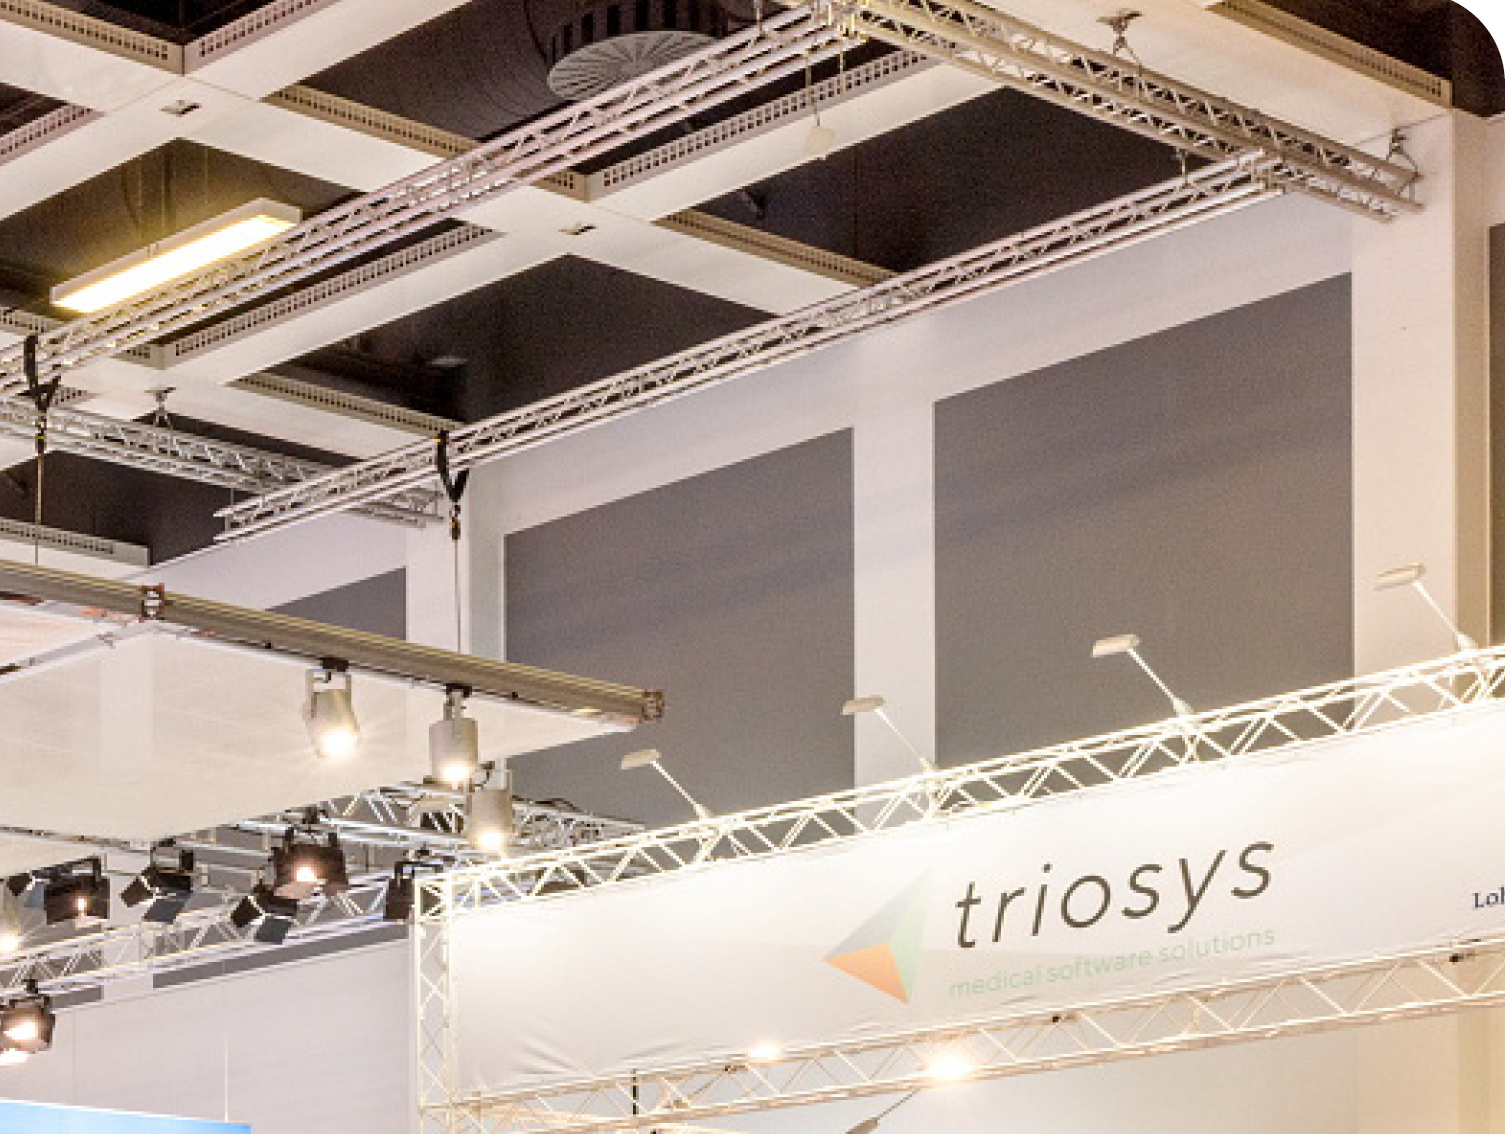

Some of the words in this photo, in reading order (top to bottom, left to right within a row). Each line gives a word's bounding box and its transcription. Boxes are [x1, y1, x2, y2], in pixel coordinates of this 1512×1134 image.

[954, 839, 1276, 952] triosys
[949, 965, 1043, 998] medical
[1046, 949, 1152, 983] software
[1158, 928, 1277, 964] solutions
